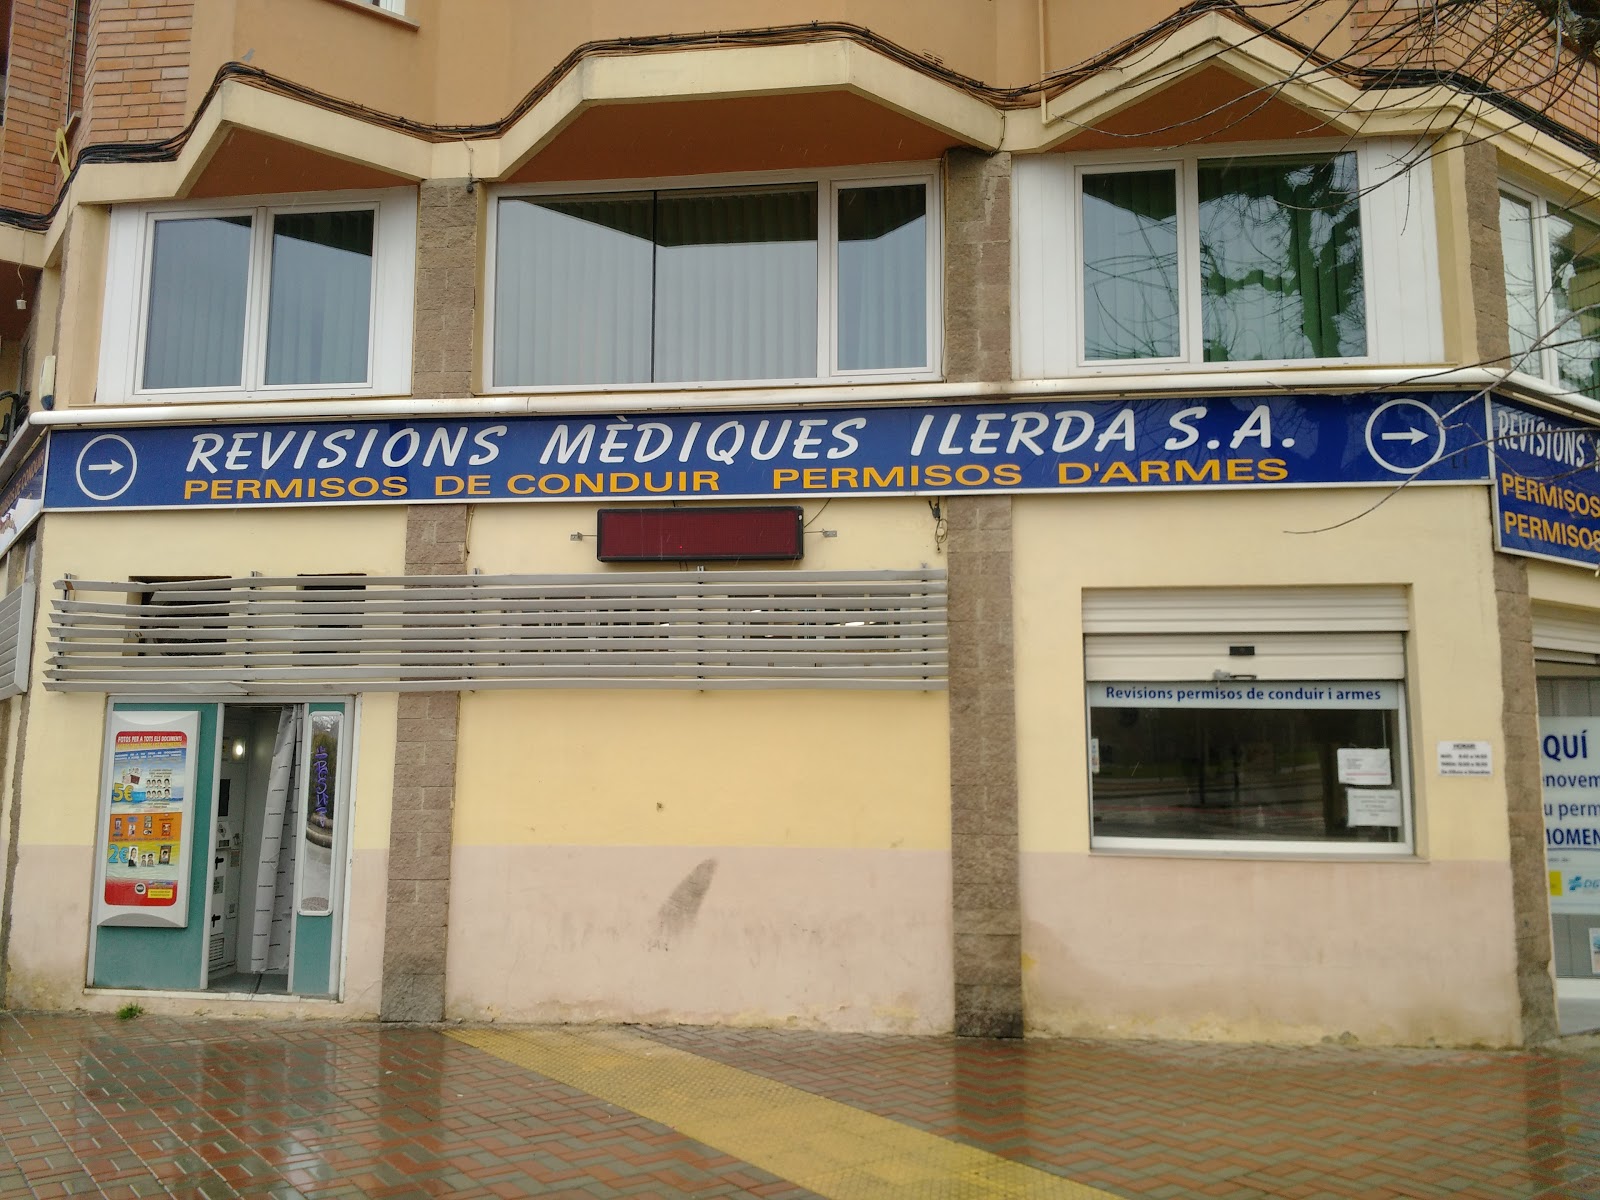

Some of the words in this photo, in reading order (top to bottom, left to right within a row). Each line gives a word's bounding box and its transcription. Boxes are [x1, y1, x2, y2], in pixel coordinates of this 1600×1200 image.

[187, 425, 507, 474] REVISIONS
[540, 416, 867, 466] MÈDIQUES
[911, 410, 1135, 456] ILERDA
[1165, 405, 1296, 450] S.A.
[1498, 410, 1585, 467] REVISIONS
[184, 476, 409, 500] PERMISOS
[435, 475, 483, 496] DE
[508, 471, 719, 495] CONDUIR
[773, 463, 1023, 490] PERMISOS
[1059, 458, 1289, 485] D'ARMES
[1501, 472, 1600, 519] PERMISOS
[1504, 511, 1600, 553] PERMISOS
[1106, 687, 1173, 700] Revisions
[1177, 687, 1242, 702] permisos
[1246, 687, 1264, 700] de
[1268, 687, 1324, 701] conduir
[1327, 688, 1332, 700] i
[1336, 689, 1382, 701] armes
[113, 782, 134, 802] 5€
[1543, 774, 1600, 788] novem
[108, 844, 129, 864] 2€
